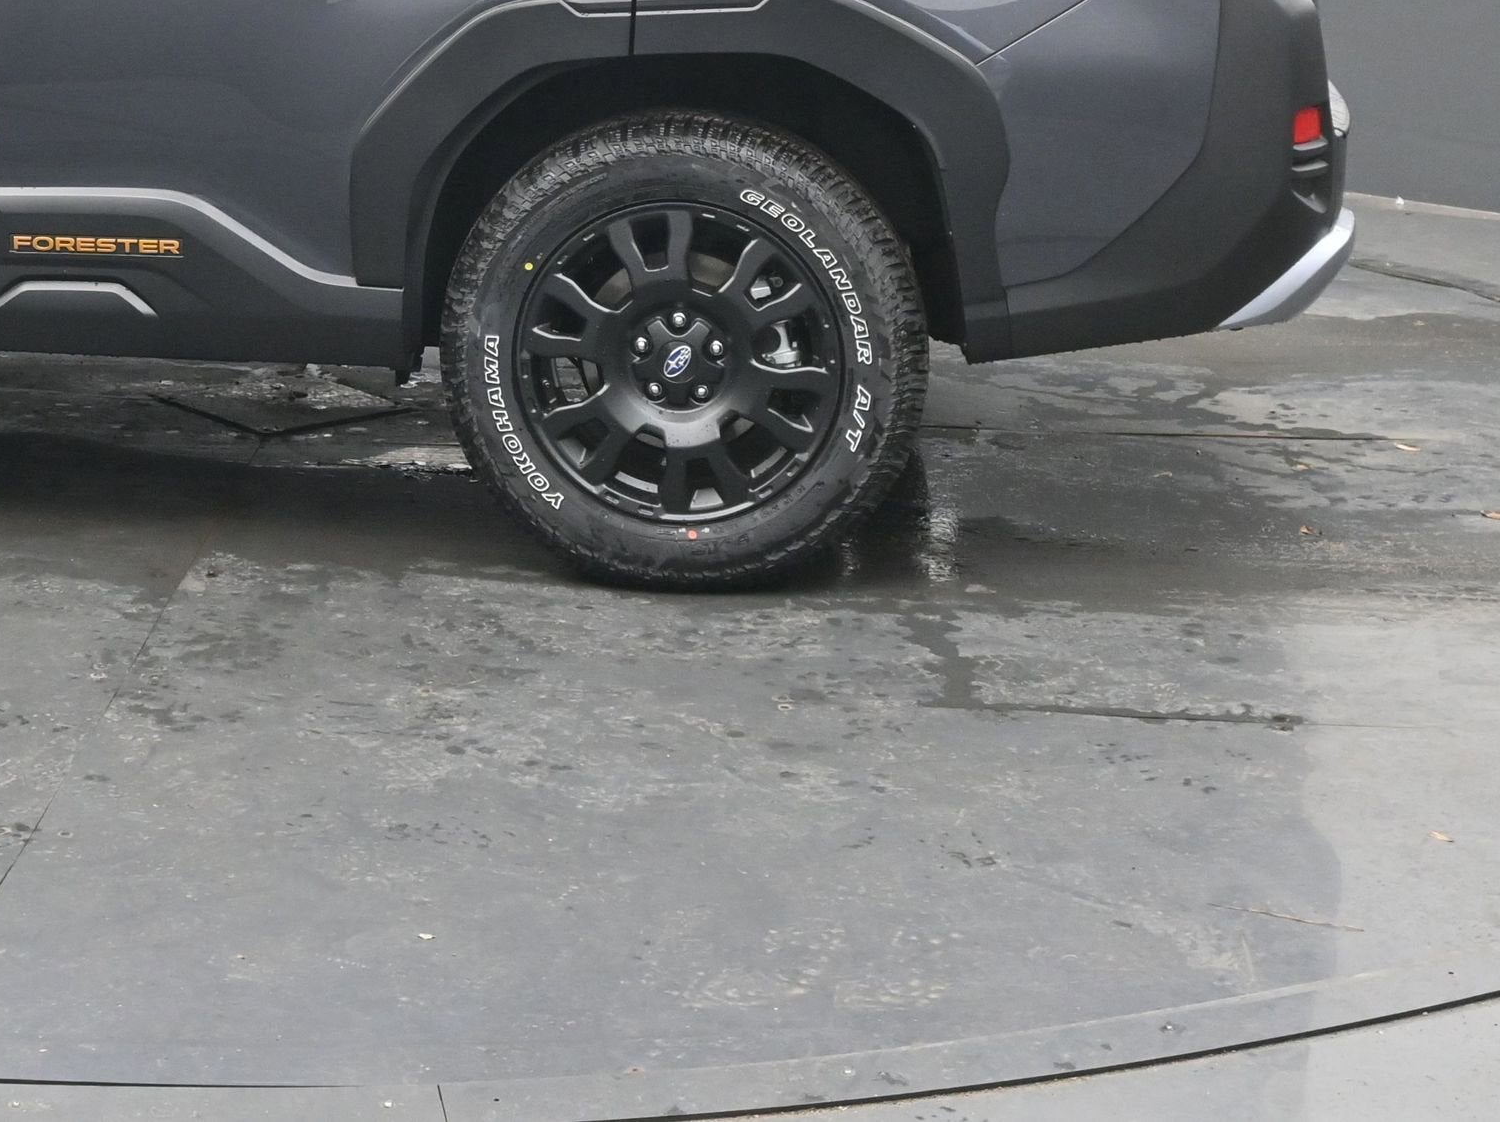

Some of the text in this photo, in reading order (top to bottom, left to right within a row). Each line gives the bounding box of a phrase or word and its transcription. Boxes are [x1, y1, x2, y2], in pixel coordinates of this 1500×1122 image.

[12, 235, 180, 255] FORESTER
[739, 188, 874, 454] GEOLANDAR A/T
[482, 334, 565, 511] YOKOHAMA
